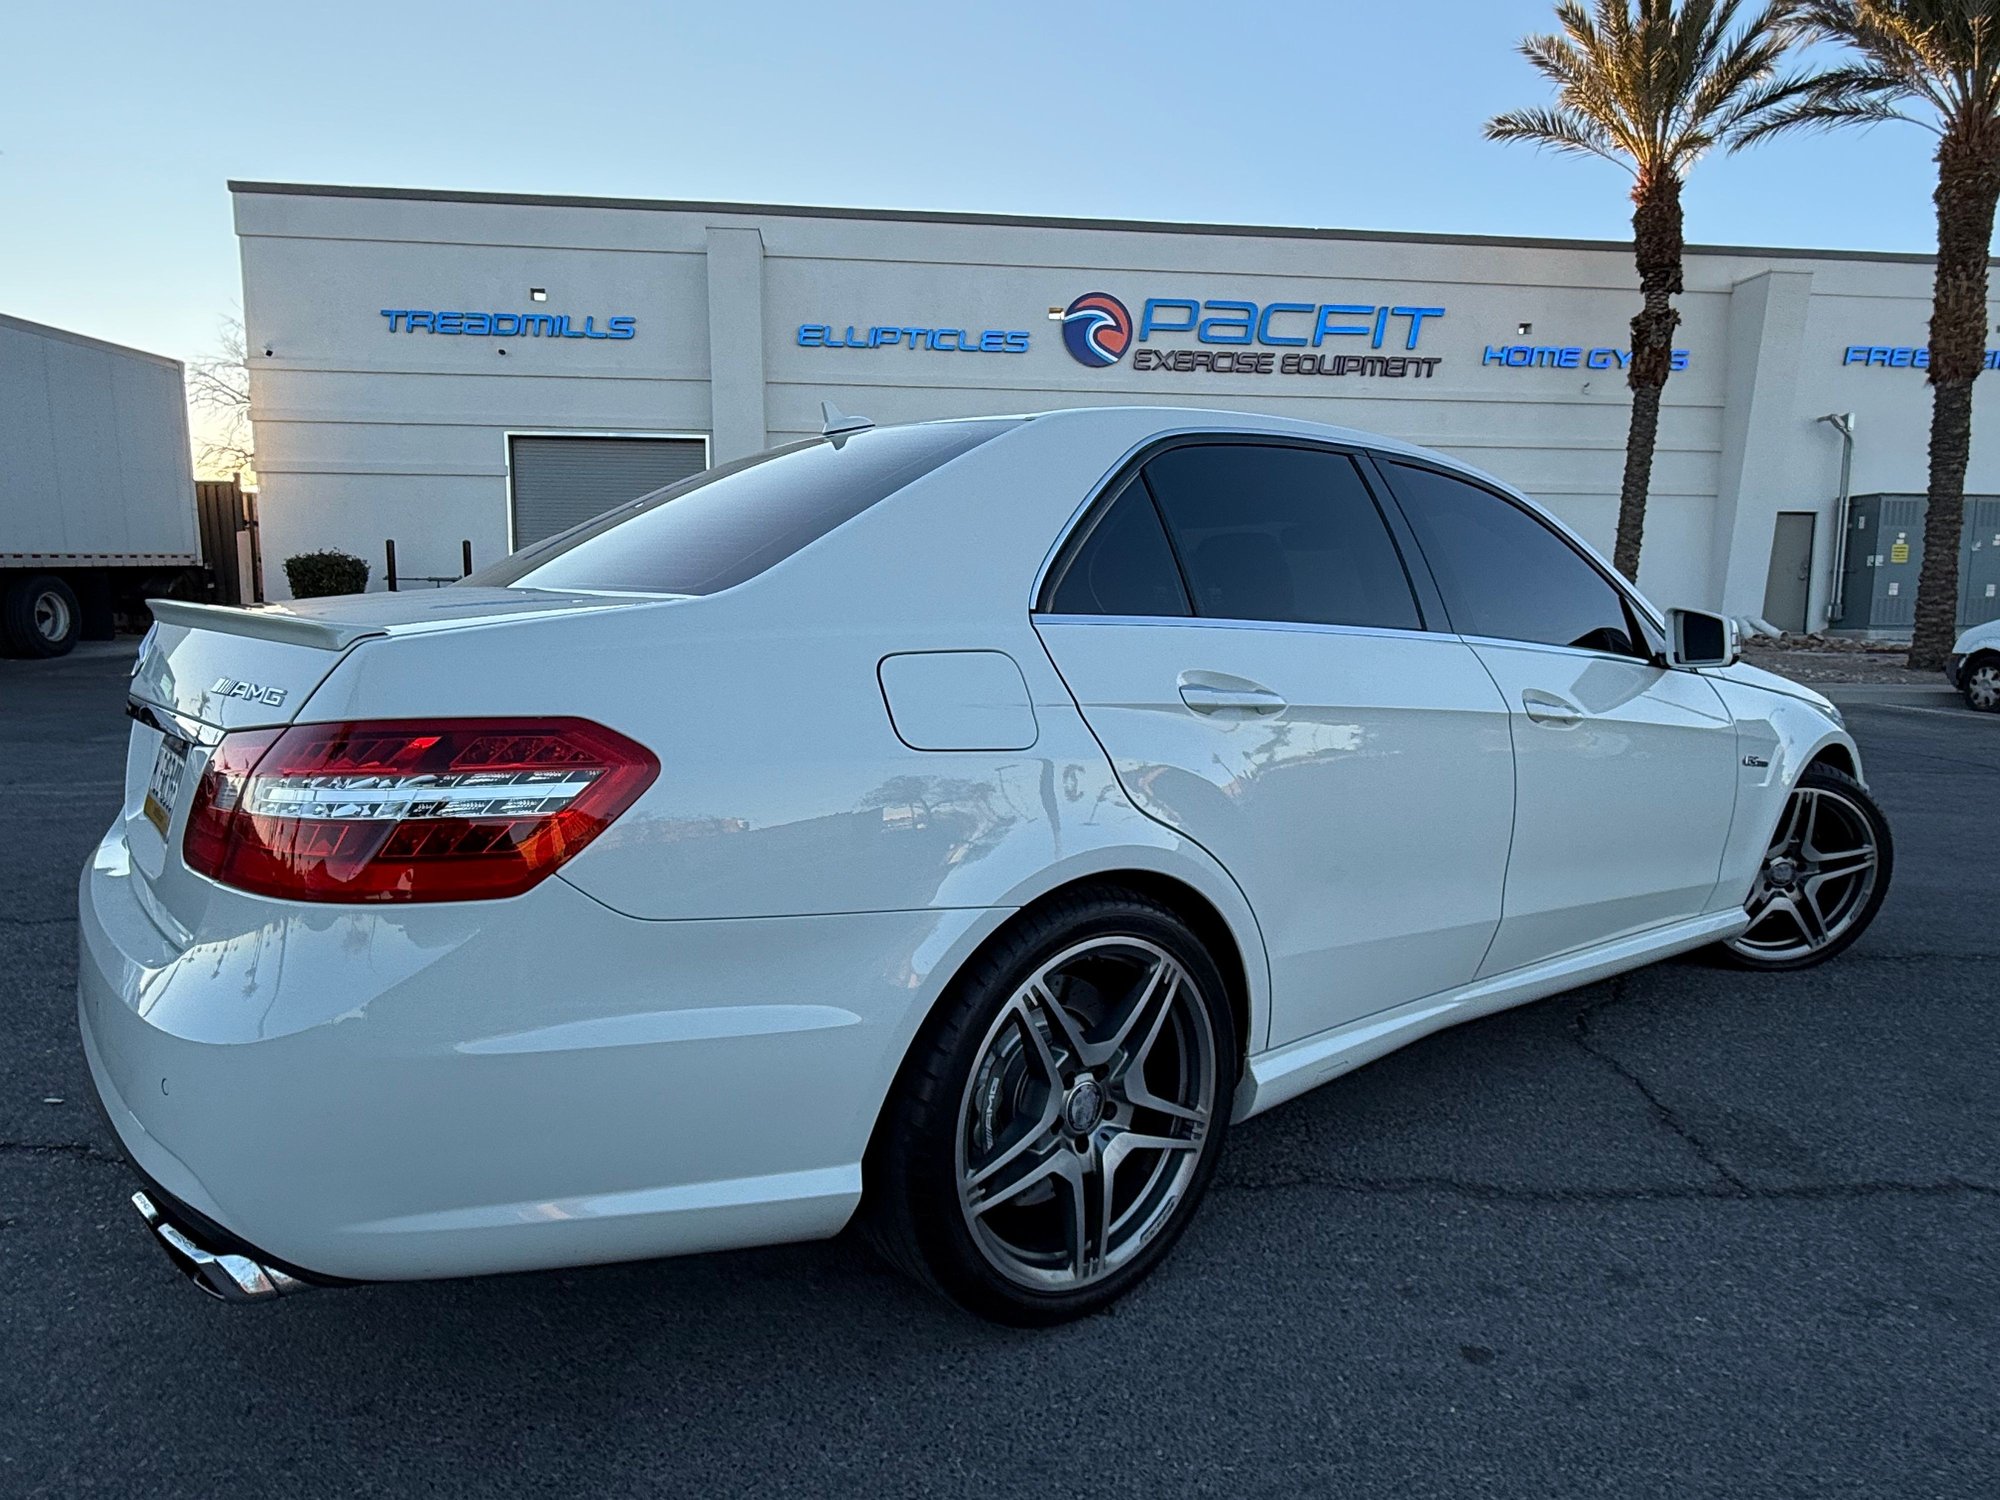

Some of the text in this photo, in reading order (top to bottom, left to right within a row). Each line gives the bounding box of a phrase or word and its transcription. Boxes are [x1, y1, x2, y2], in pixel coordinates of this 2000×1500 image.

[380, 309, 636, 340] TREADMILLS
[797, 323, 1030, 354] ELLIPTICLES
[1132, 348, 1443, 379] EXERCISE EQUIPMENT
[1482, 344, 1690, 371] HOME GYS
[1843, 346, 1930, 369] FREE
[229, 681, 288, 708] AMG
